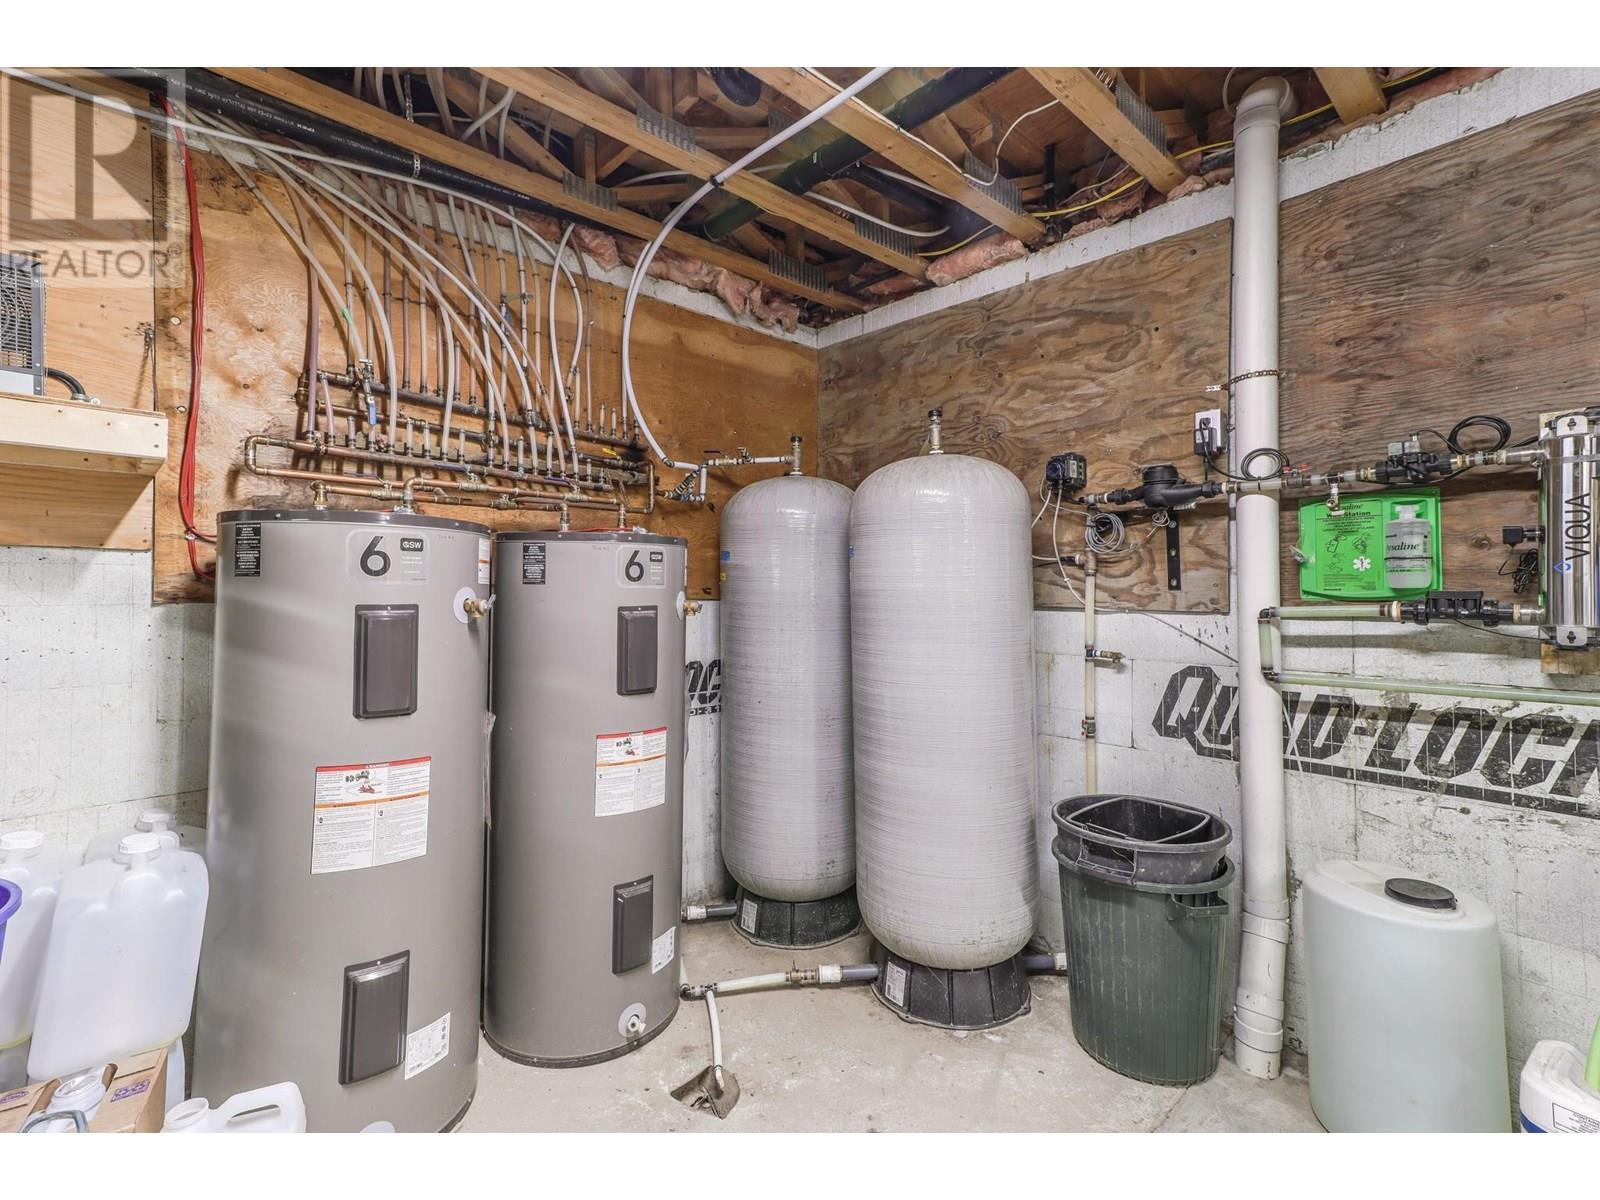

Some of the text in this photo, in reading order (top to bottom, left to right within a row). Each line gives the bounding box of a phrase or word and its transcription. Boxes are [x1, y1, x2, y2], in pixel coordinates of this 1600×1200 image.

[1565, 493, 1591, 560] VIQUA
[360, 536, 391, 577] 6
[402, 541, 422, 549] GSW
[625, 550, 644, 582] 6
